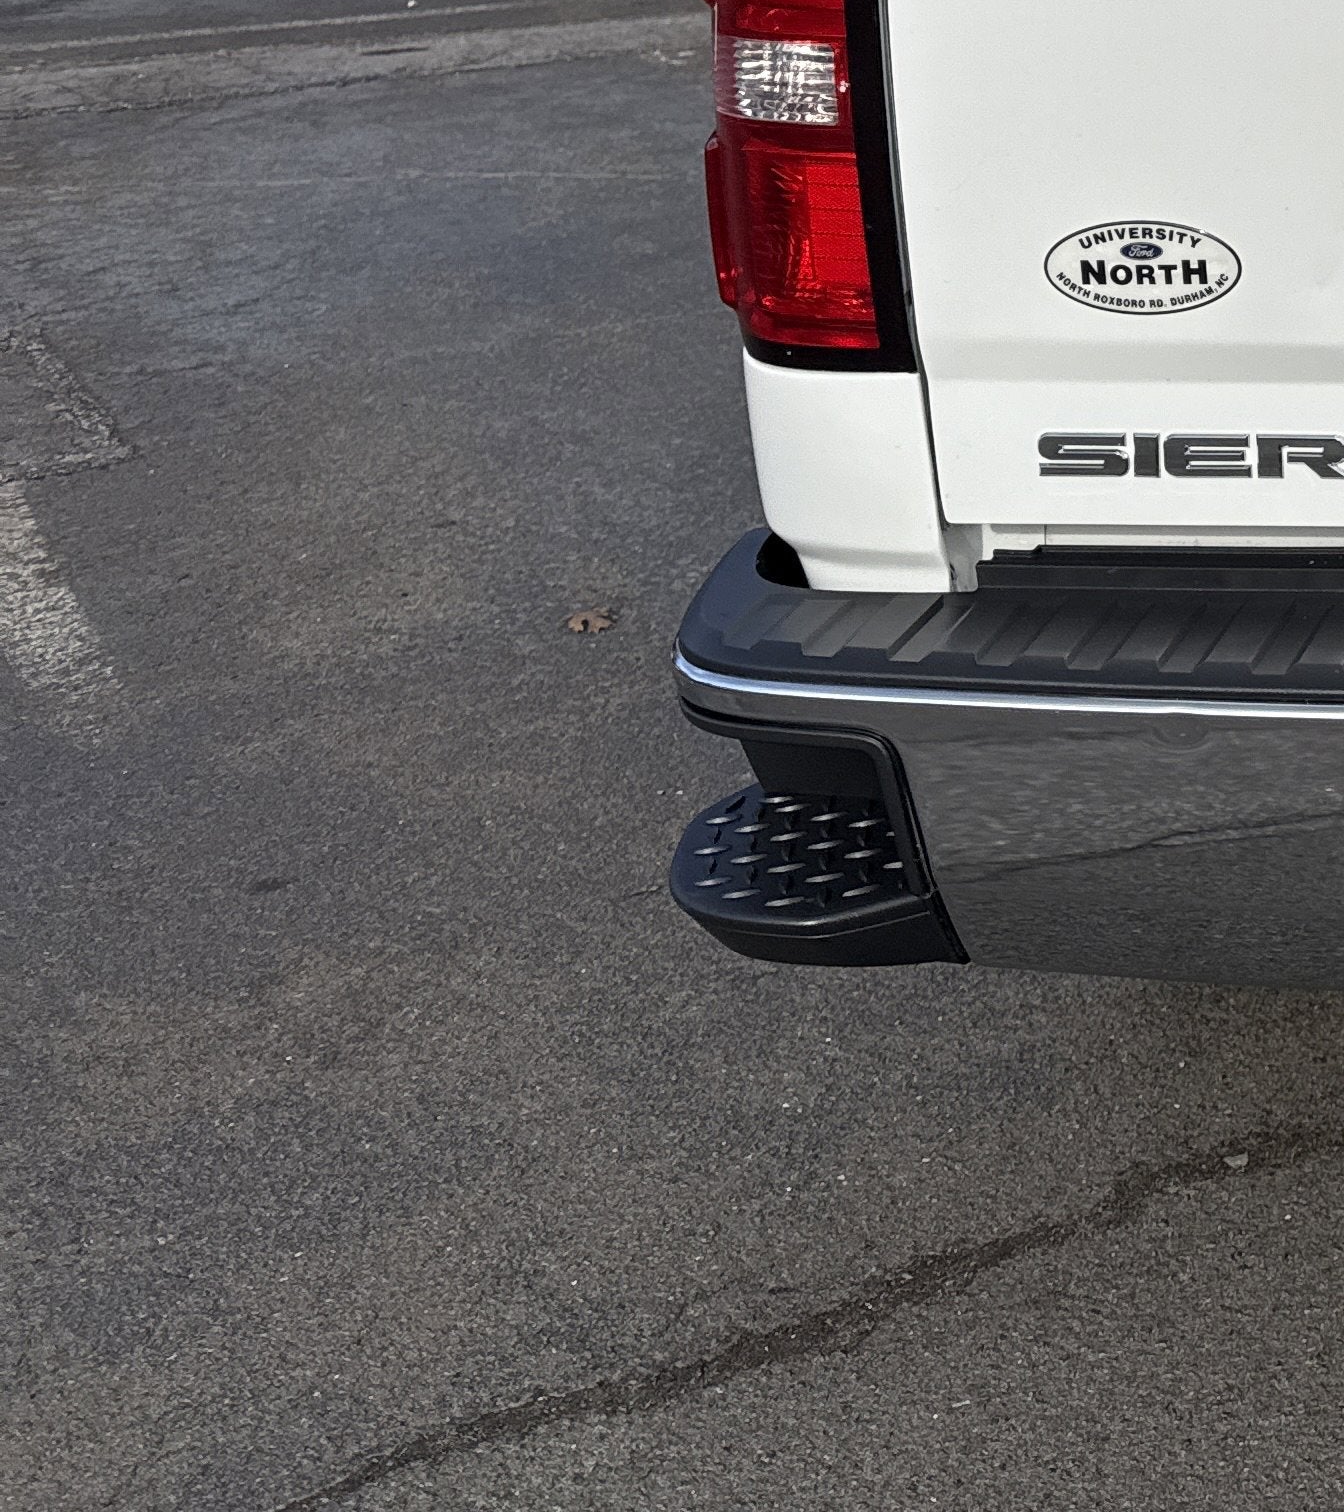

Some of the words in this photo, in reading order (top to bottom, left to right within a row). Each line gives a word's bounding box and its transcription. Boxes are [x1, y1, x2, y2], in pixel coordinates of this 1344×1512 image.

[1078, 227, 1202, 249] UNIVERSITY
[1127, 243, 1156, 258] Ford
[1079, 259, 1209, 285] NORTH
[1056, 271, 1091, 299] NORTH
[1093, 292, 1146, 309] ROXBORO
[1149, 298, 1168, 308] RD.
[1170, 285, 1218, 307] DURHAM,
[1214, 272, 1230, 289] NC
